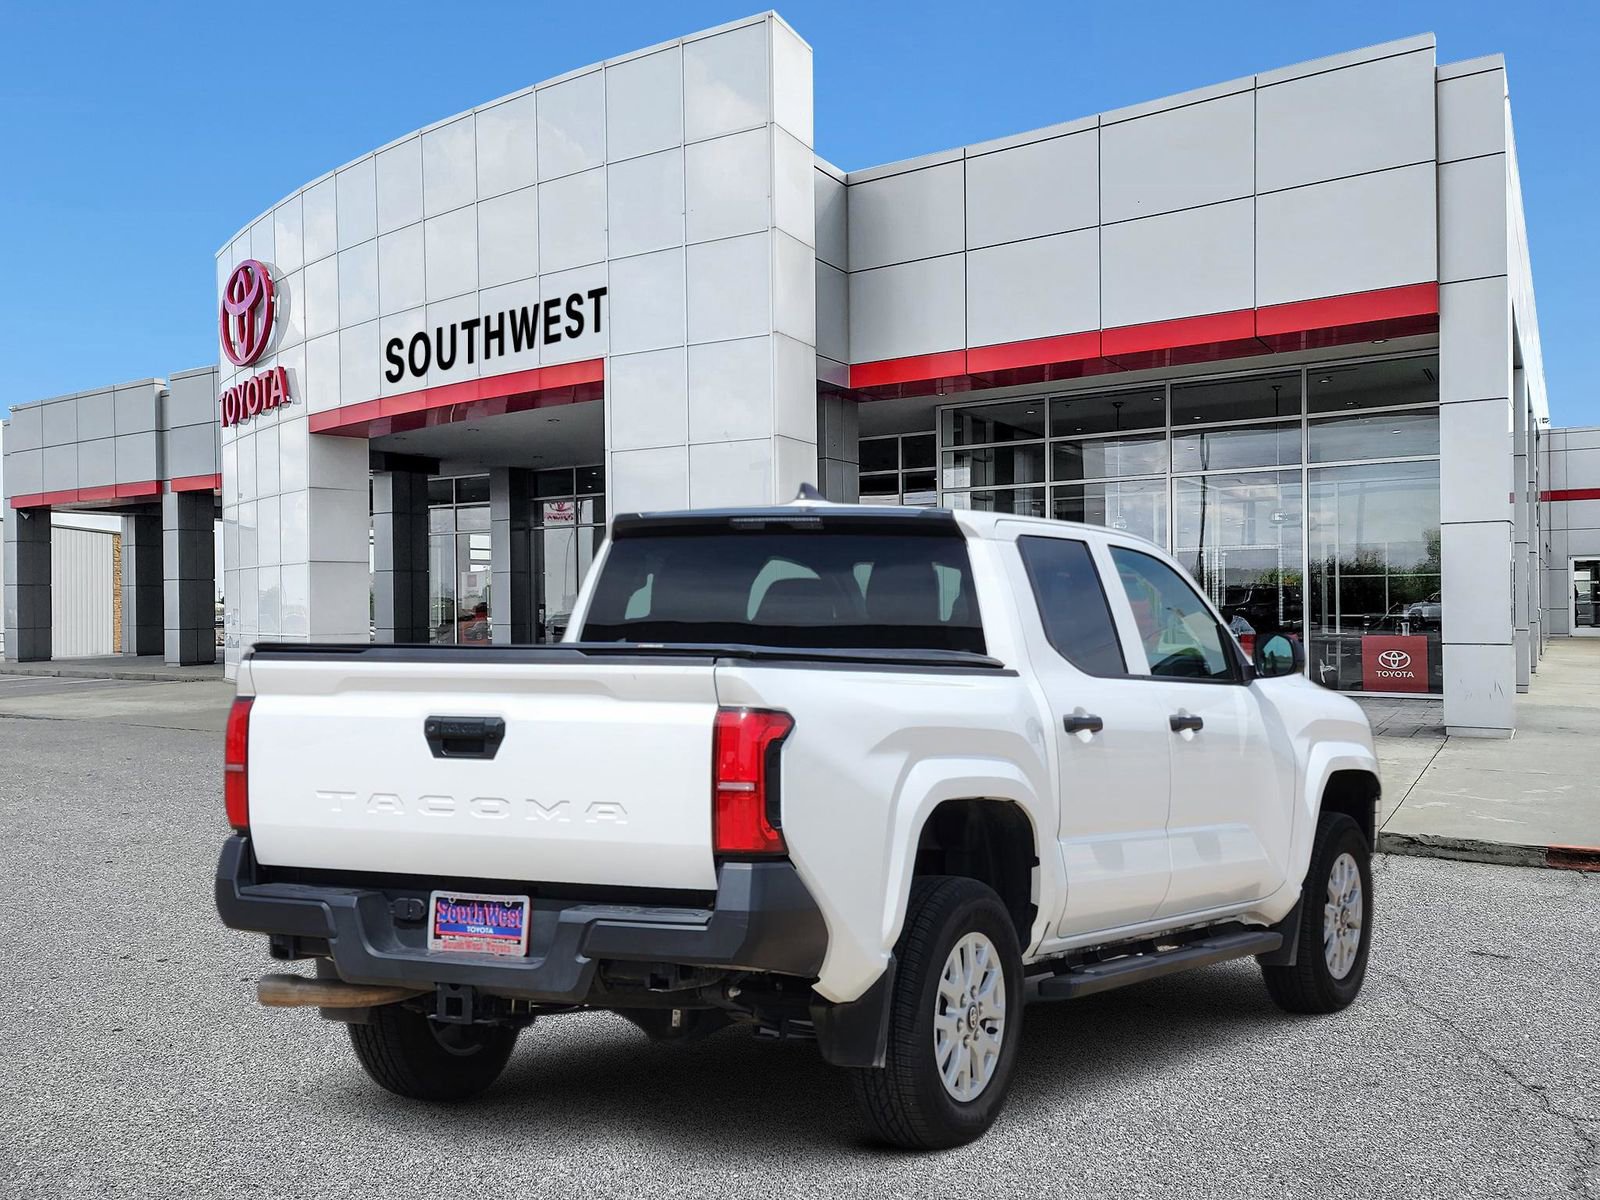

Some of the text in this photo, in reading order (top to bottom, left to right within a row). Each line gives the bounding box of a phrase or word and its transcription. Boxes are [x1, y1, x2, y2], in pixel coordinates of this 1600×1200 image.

[385, 286, 608, 384] SOUTHWEST
[218, 366, 290, 428] TOYOTA
[1376, 670, 1414, 678] TOYOTA
[316, 789, 629, 825] TACOMA
[466, 925, 494, 934] TOYOTA
